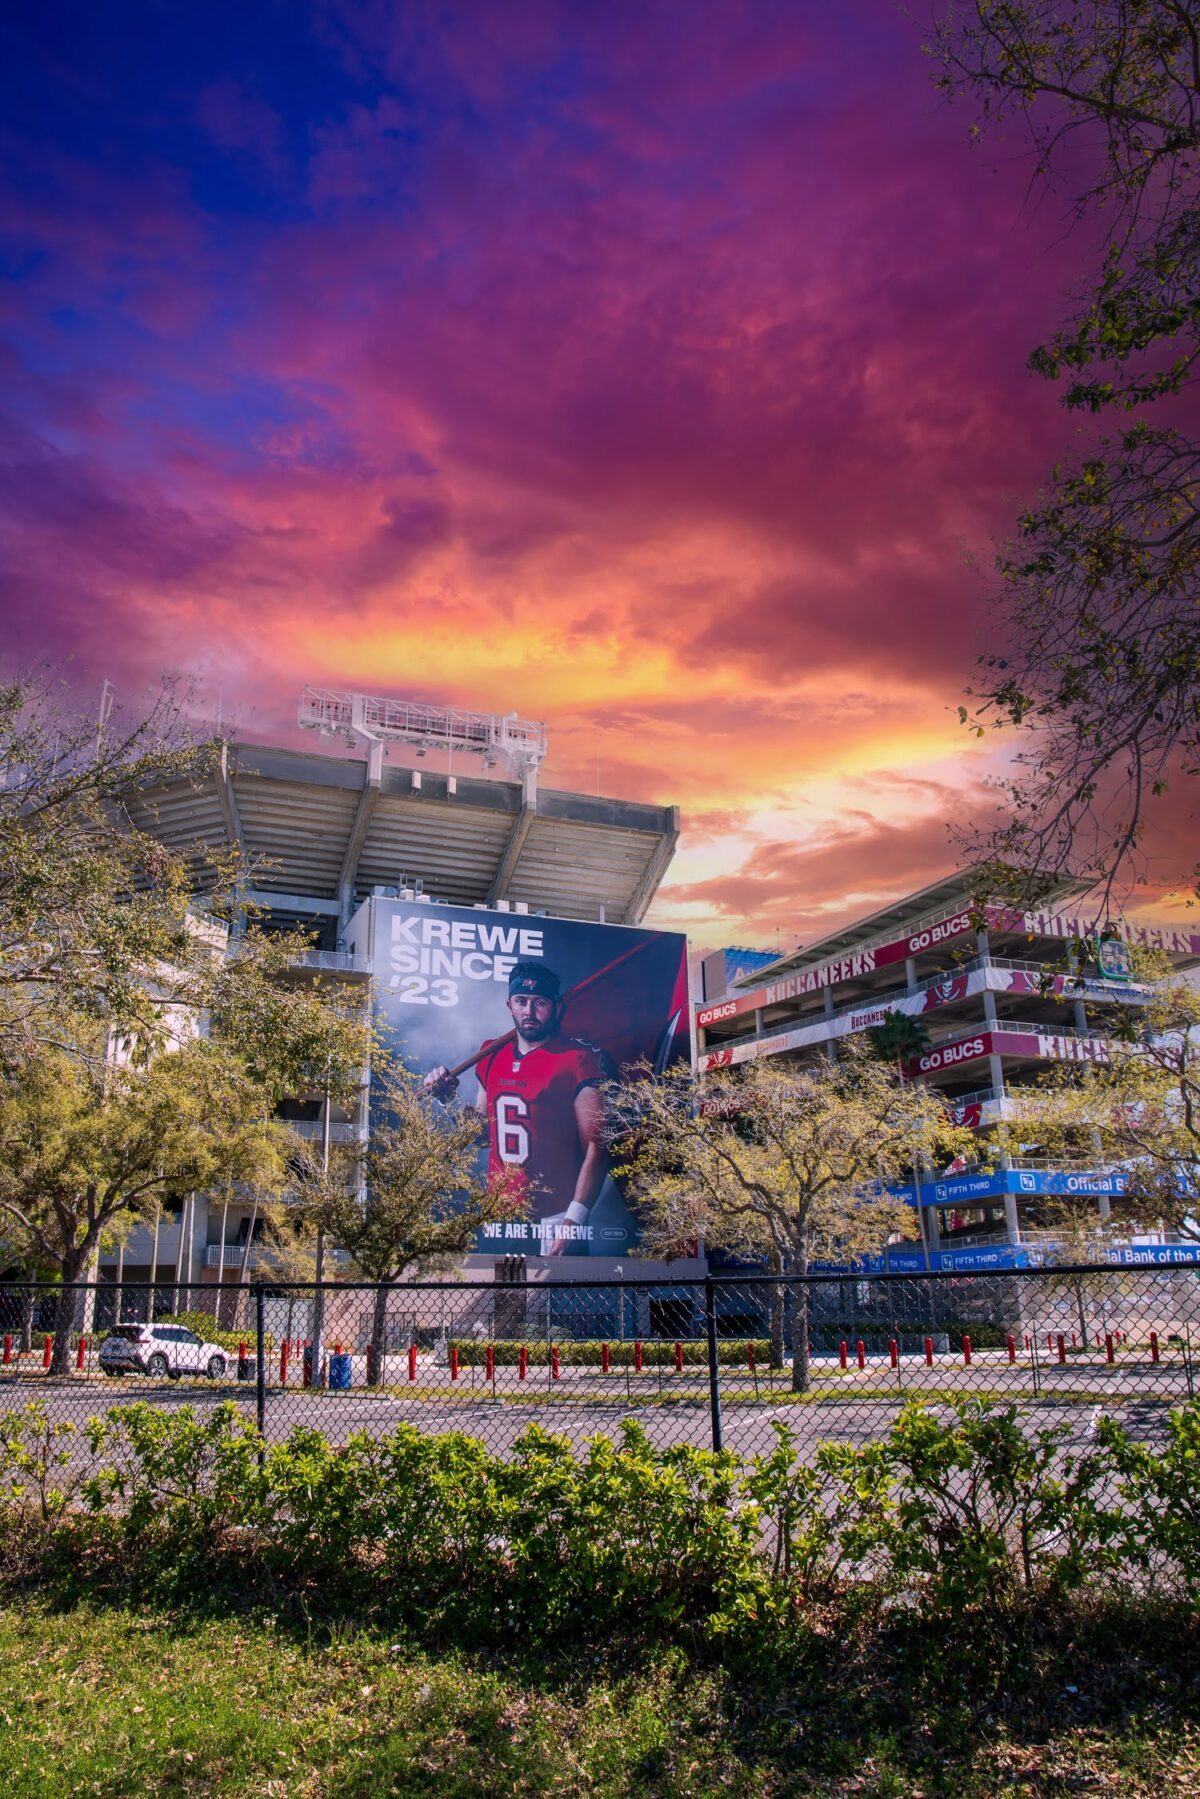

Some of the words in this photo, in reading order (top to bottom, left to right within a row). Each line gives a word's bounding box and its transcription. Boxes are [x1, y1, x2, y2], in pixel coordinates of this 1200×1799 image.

[391, 915, 544, 957] KREWE
[909, 934, 931, 952] GO
[932, 913, 971, 941] BUCS
[390, 944, 518, 983] SINCE
[390, 974, 459, 1007] '23
[700, 1010, 713, 1024] GO
[713, 1003, 737, 1020] BUCS
[851, 1005, 892, 1030] BUCCANEE
[919, 1054, 942, 1071] GO
[943, 1039, 984, 1064] BUCS
[496, 1095, 529, 1164] 6
[948, 1184, 968, 1195] FIFTH
[969, 1180, 990, 1192] THIRD
[1068, 1177, 1112, 1191] Official
[484, 1222, 502, 1239] WE
[505, 1223, 528, 1239] ARE
[530, 1224, 552, 1240] THE
[554, 1225, 594, 1241] KREWE
[881, 1259, 898, 1268] FTH
[899, 1259, 918, 1268] THIRD
[954, 1256, 974, 1266] FIFTH
[975, 1254, 998, 1264] THIRD
[1125, 1249, 1156, 1262] Bank
[1158, 1250, 1172, 1262] of
[1173, 1250, 1194, 1261] the
